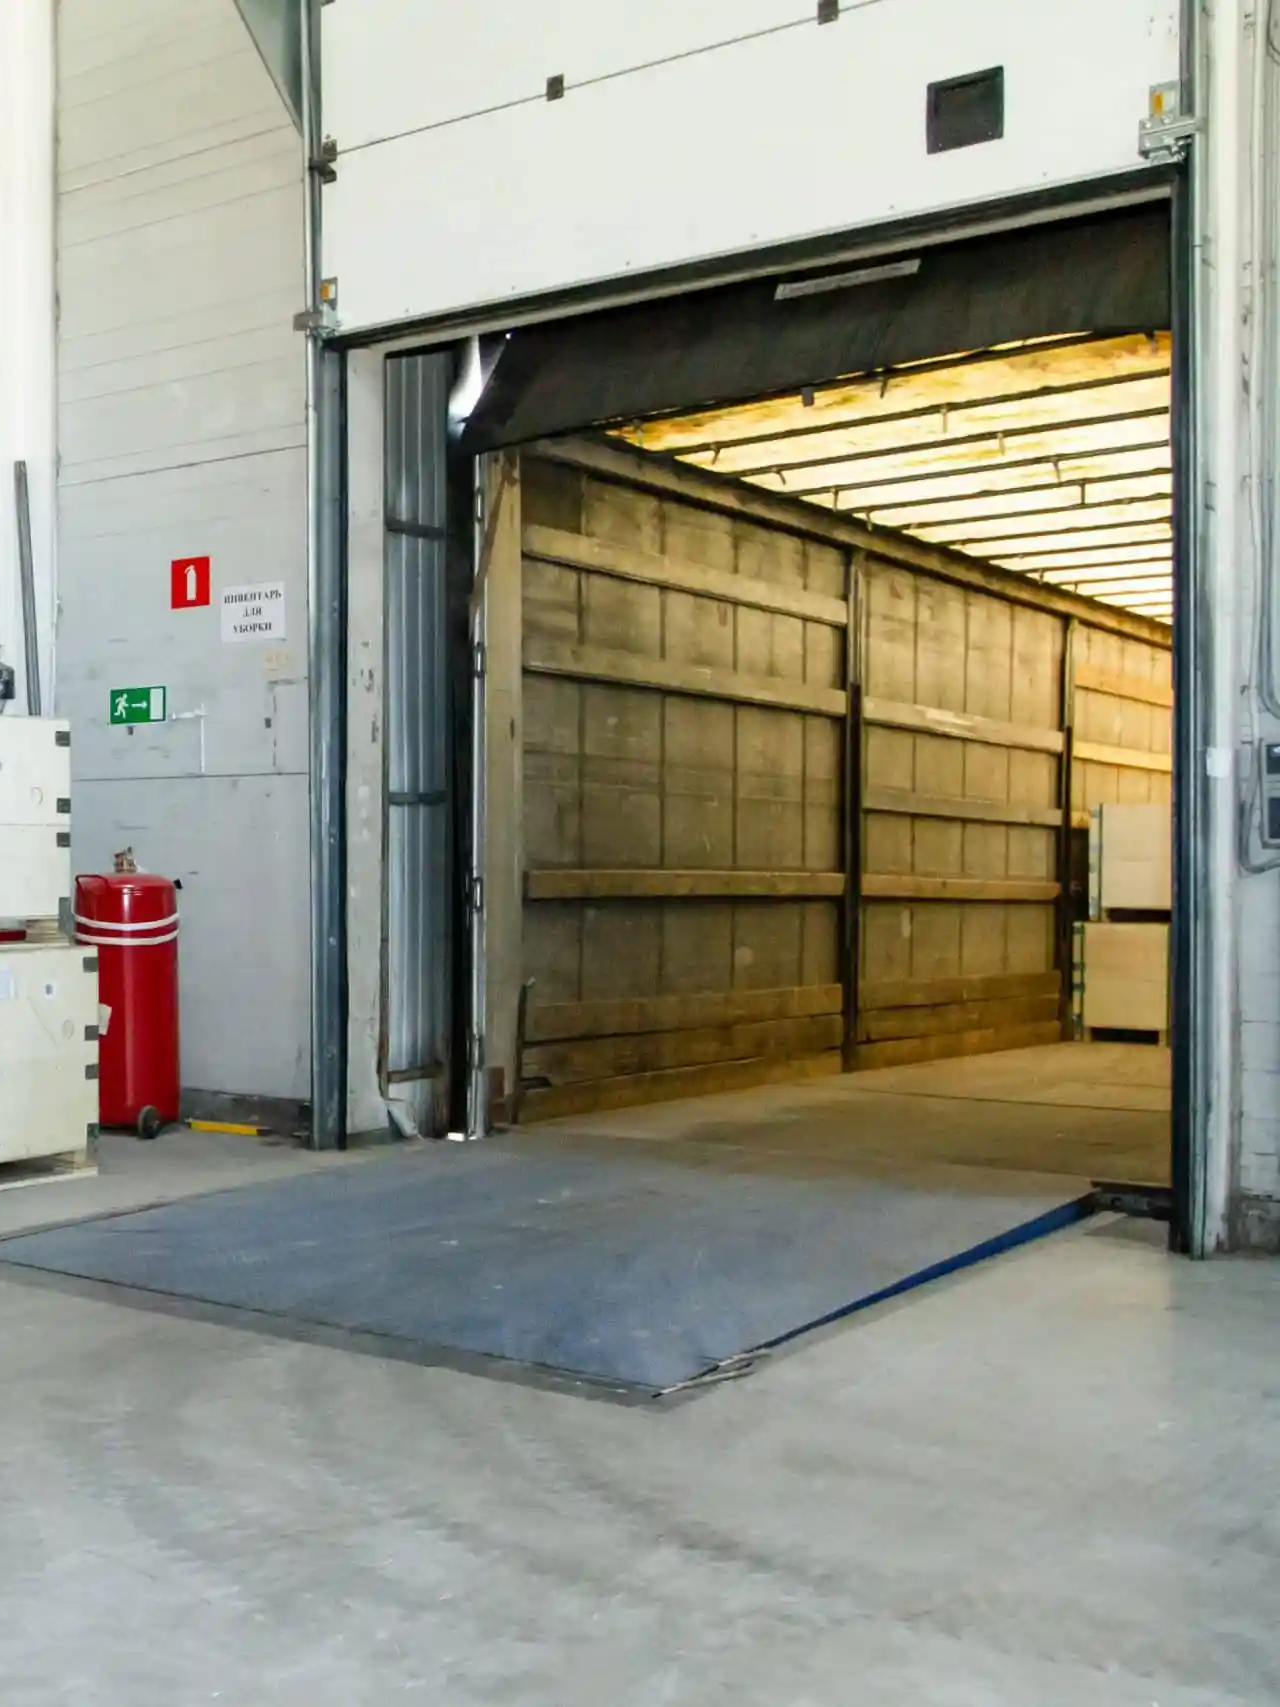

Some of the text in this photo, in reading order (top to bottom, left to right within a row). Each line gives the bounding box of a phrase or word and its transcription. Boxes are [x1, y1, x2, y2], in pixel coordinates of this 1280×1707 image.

[224, 590, 282, 604] ИНВЕНТАРЬ
[243, 607, 262, 617] ДЛЯ
[233, 622, 272, 633] УБОРКИ
